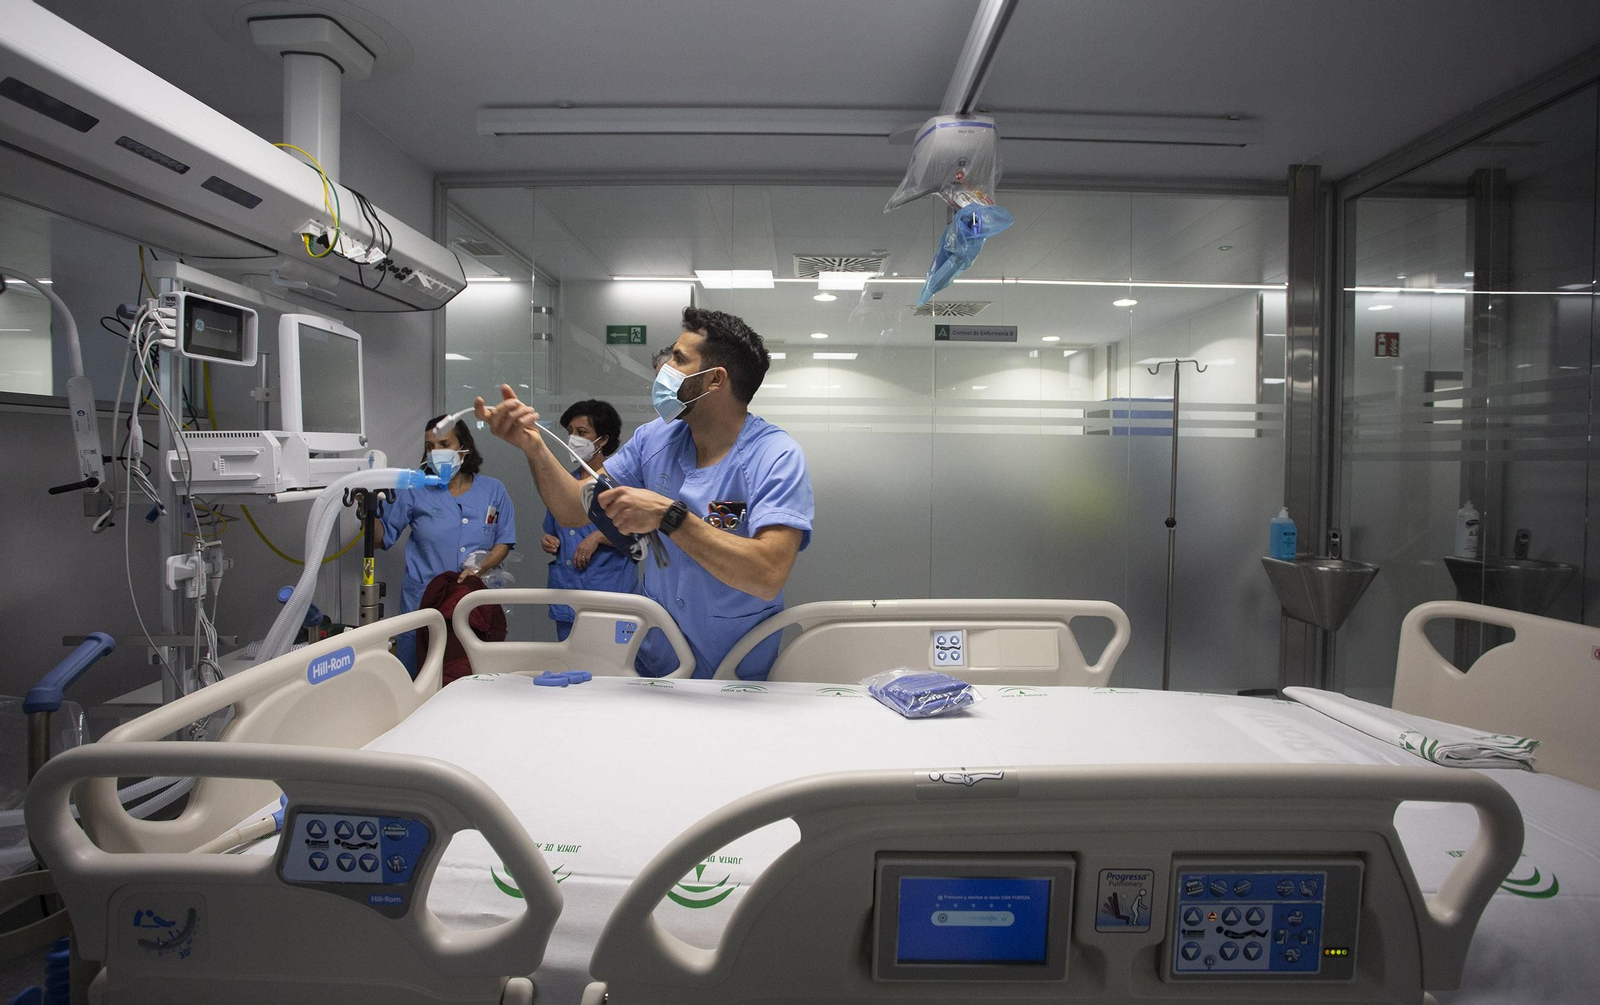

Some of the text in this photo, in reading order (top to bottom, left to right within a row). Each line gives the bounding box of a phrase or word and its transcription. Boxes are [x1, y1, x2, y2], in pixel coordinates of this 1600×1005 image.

[312, 655, 351, 679] Hill-Rom
[543, 843, 555, 852] DE
[556, 844, 582, 853] JUNTA
[719, 855, 744, 865] JUNTA
[1105, 872, 1148, 881] Progressa
[1108, 880, 1144, 888] Pulmonary
[370, 895, 402, 903] Hill-Rom
